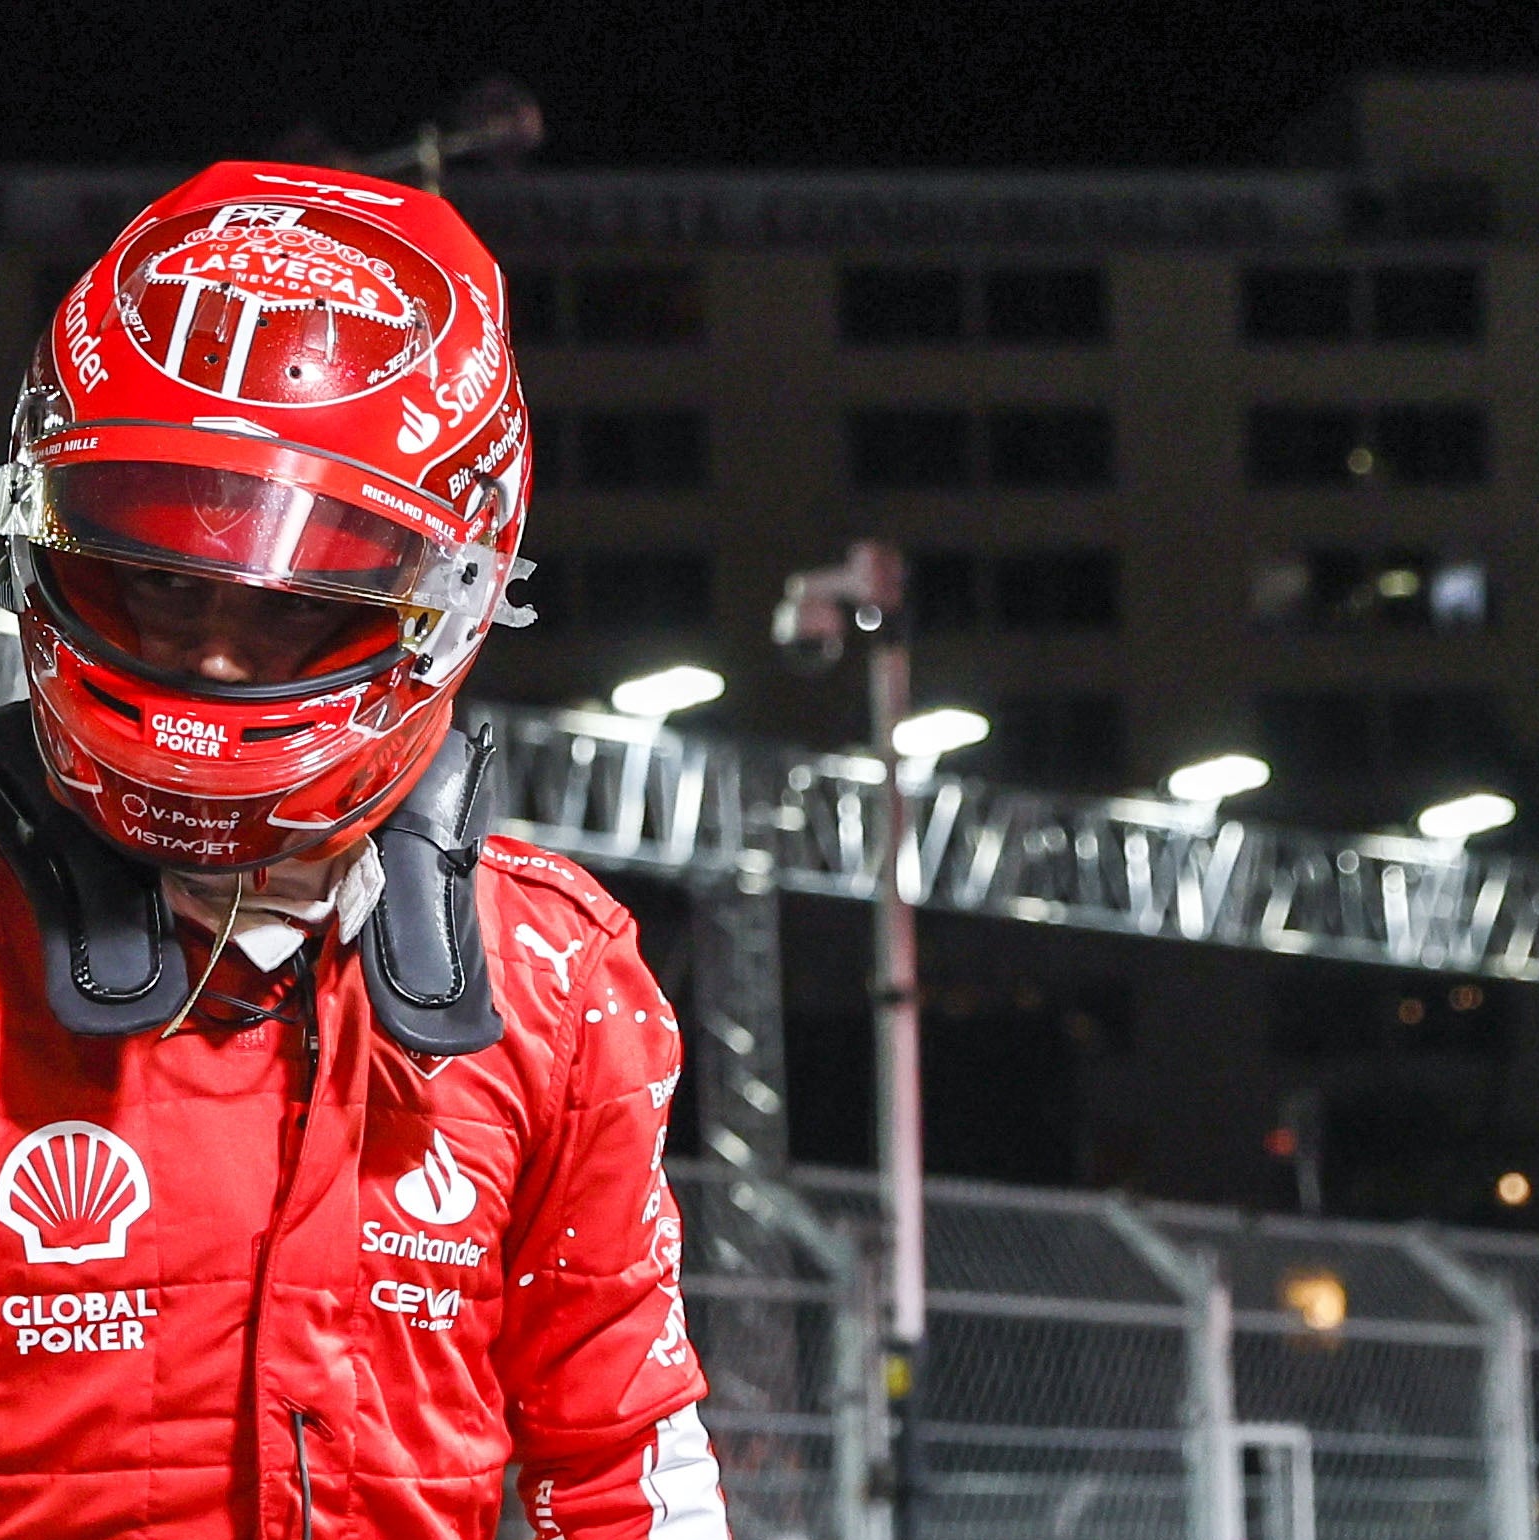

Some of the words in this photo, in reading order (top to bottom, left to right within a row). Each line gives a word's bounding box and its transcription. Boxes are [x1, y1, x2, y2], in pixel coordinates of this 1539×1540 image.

[189, 229, 390, 275] WELCOME
[209, 243, 228, 251] TO
[237, 240, 353, 276] Fabulous
[183, 253, 250, 275] LAS
[262, 255, 379, 310] VEGAS
[236, 272, 311, 294] NEVADA
[64, 437, 99, 452] MILLE
[362, 483, 423, 521] RICHARD
[425, 512, 456, 540] MILLE
[152, 714, 228, 742] GLOBAL
[155, 732, 221, 758] POKER
[151, 806, 239, 829] V-Power
[362, 1221, 488, 1267] Santander
[2, 1289, 157, 1327] GLOBAL
[17, 1321, 145, 1355] POKER
